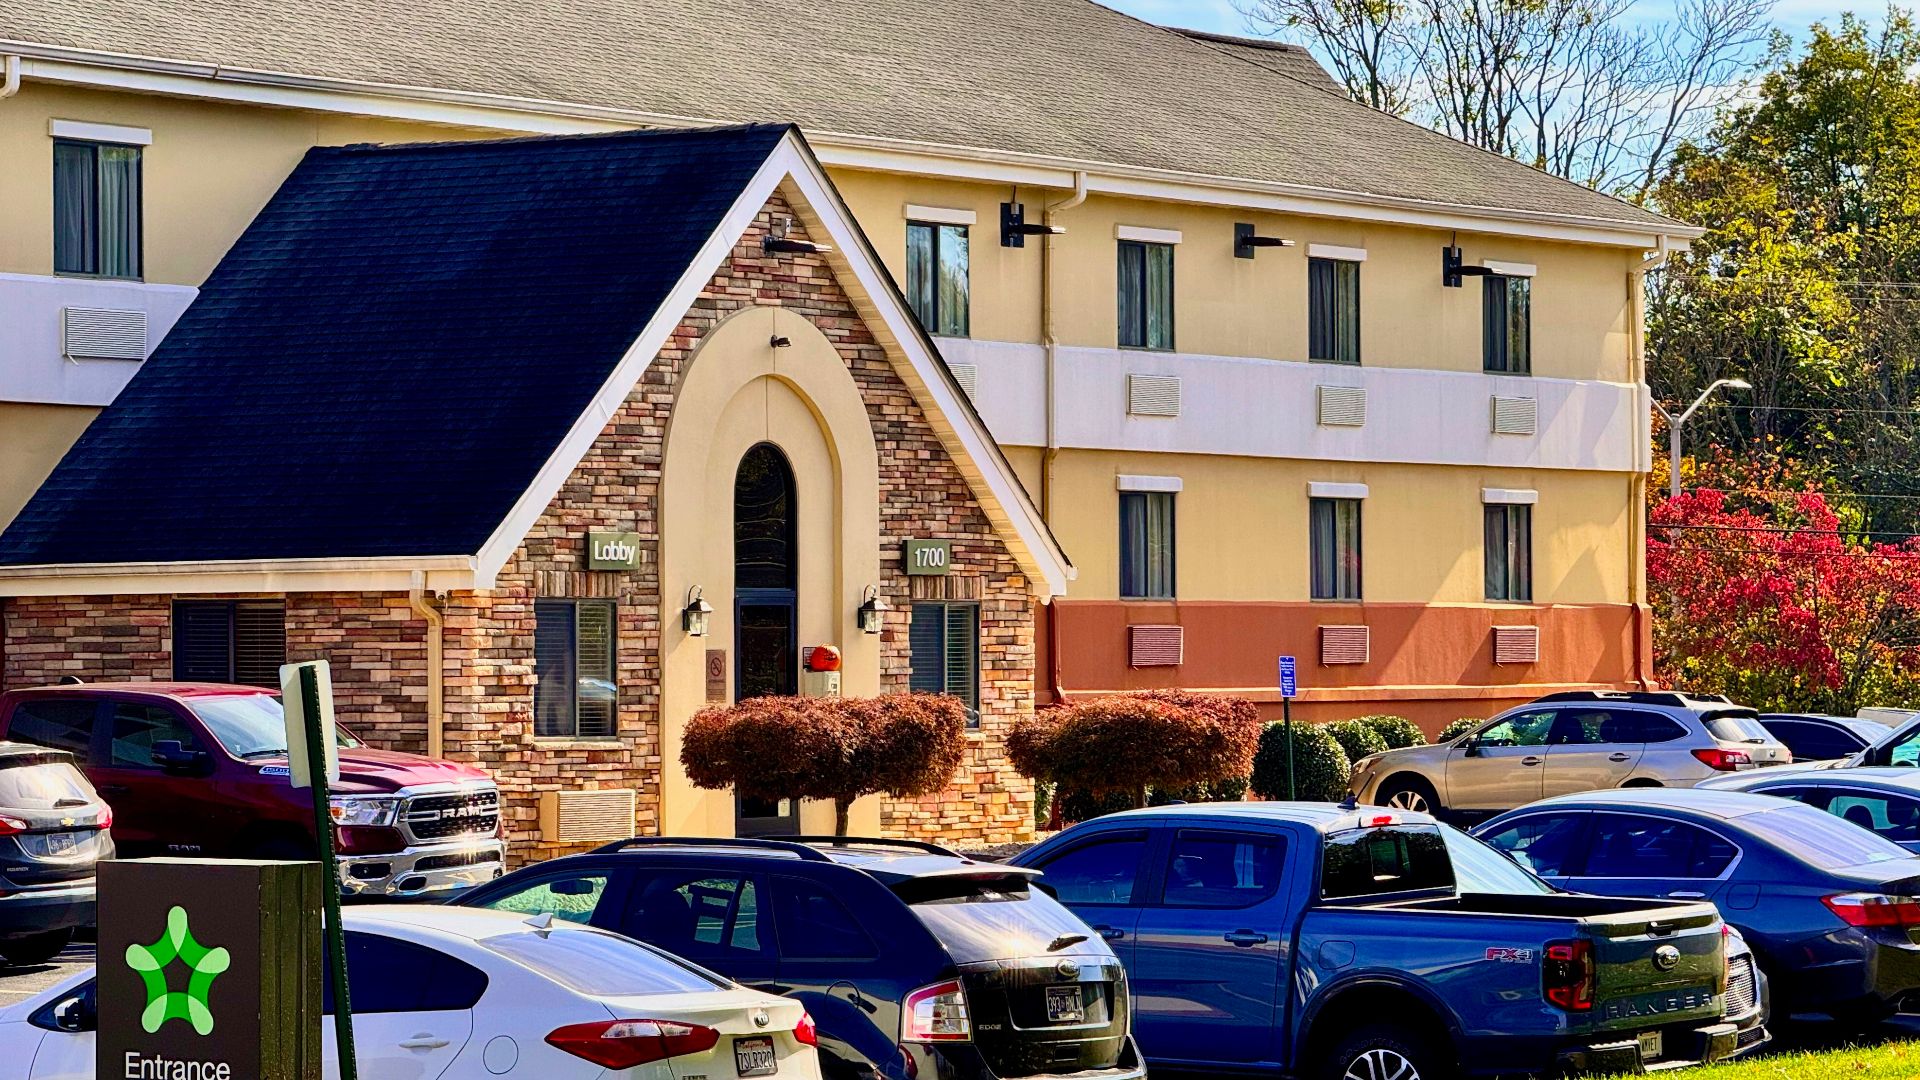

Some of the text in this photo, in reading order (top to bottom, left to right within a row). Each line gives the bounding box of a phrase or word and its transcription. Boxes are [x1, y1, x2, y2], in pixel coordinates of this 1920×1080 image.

[594, 540, 636, 565] Lobby
[914, 547, 945, 567] 1700
[442, 805, 480, 818] RAM
[1485, 947, 1533, 961] FX4
[1605, 993, 1713, 1019] RANGER
[125, 1051, 231, 1080] Entrance
[737, 1050, 774, 1070] 7SLR320
